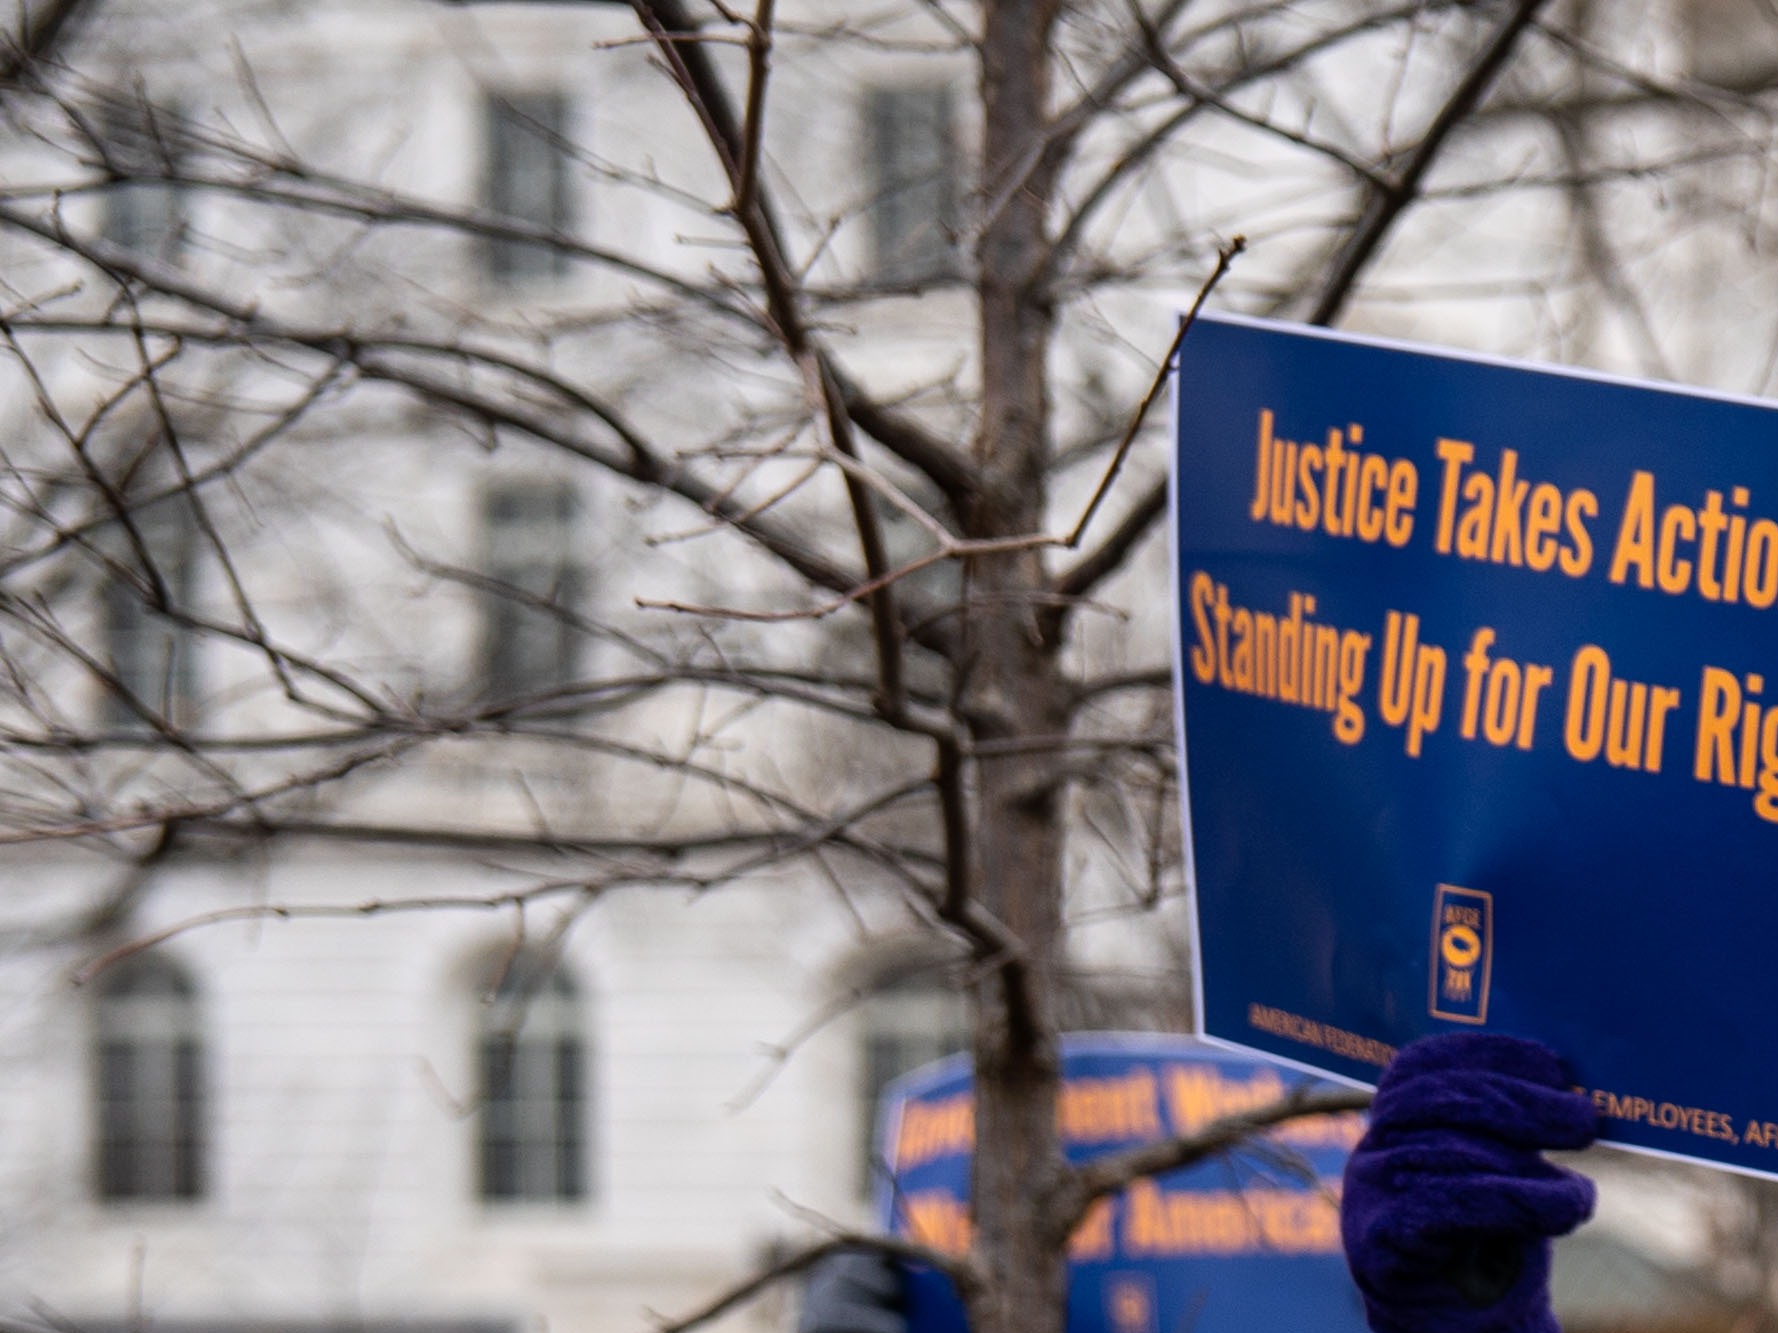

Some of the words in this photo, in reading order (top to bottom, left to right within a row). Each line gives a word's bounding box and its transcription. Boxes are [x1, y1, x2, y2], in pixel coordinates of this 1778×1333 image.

[1252, 411, 1417, 546] Justice
[1437, 440, 1597, 576] Takes
[1192, 573, 1370, 743] Standing
[1380, 612, 1445, 756] Up
[1462, 629, 1552, 748] for
[1566, 646, 1679, 771] Our
